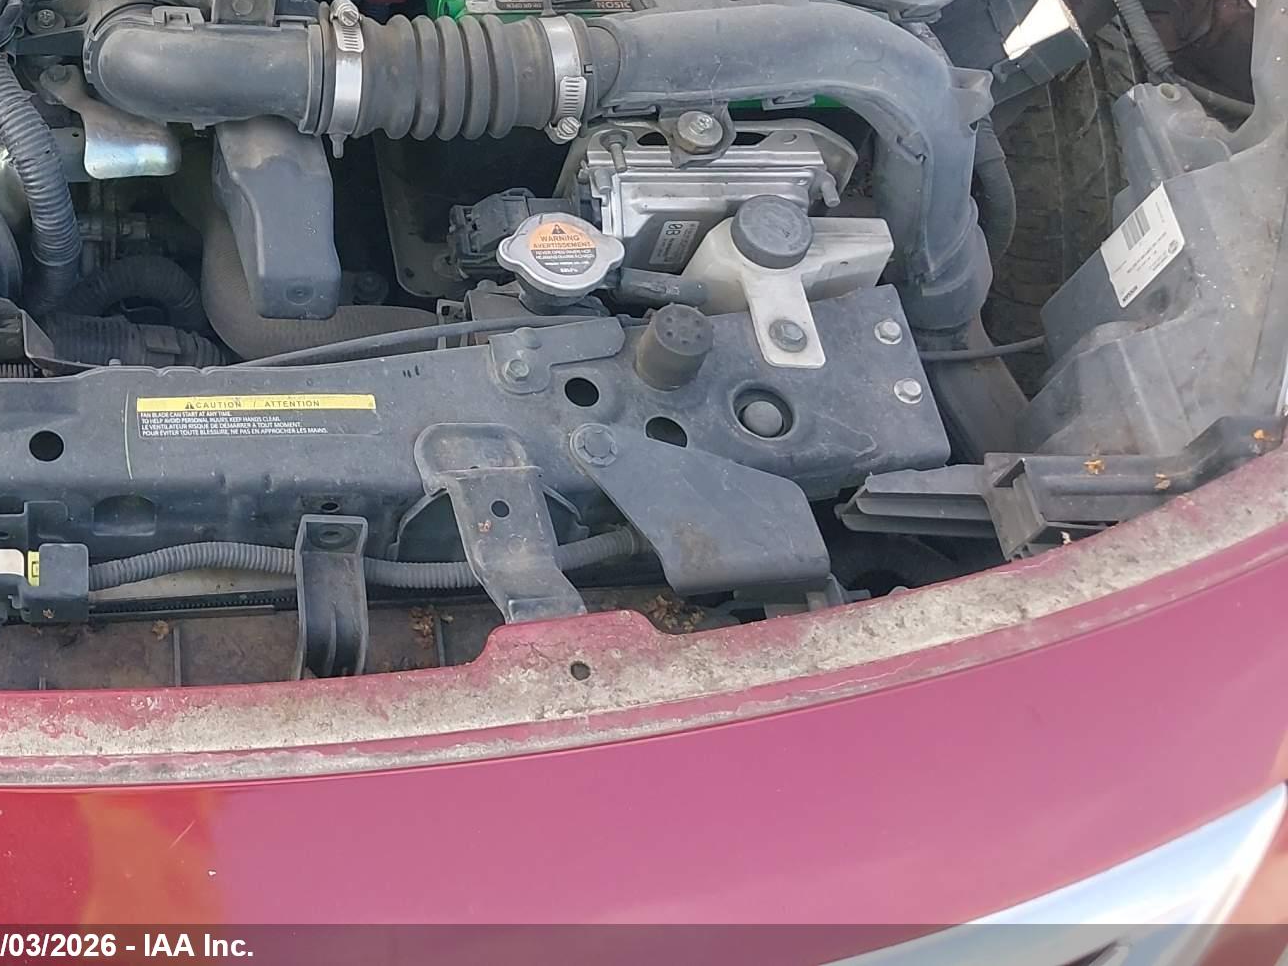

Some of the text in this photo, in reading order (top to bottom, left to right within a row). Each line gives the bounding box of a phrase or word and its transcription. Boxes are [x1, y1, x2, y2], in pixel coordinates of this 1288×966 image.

[540, 234, 580, 242] WARNING
[195, 401, 242, 409] CAUTION
[264, 399, 320, 408] ATTENTION
